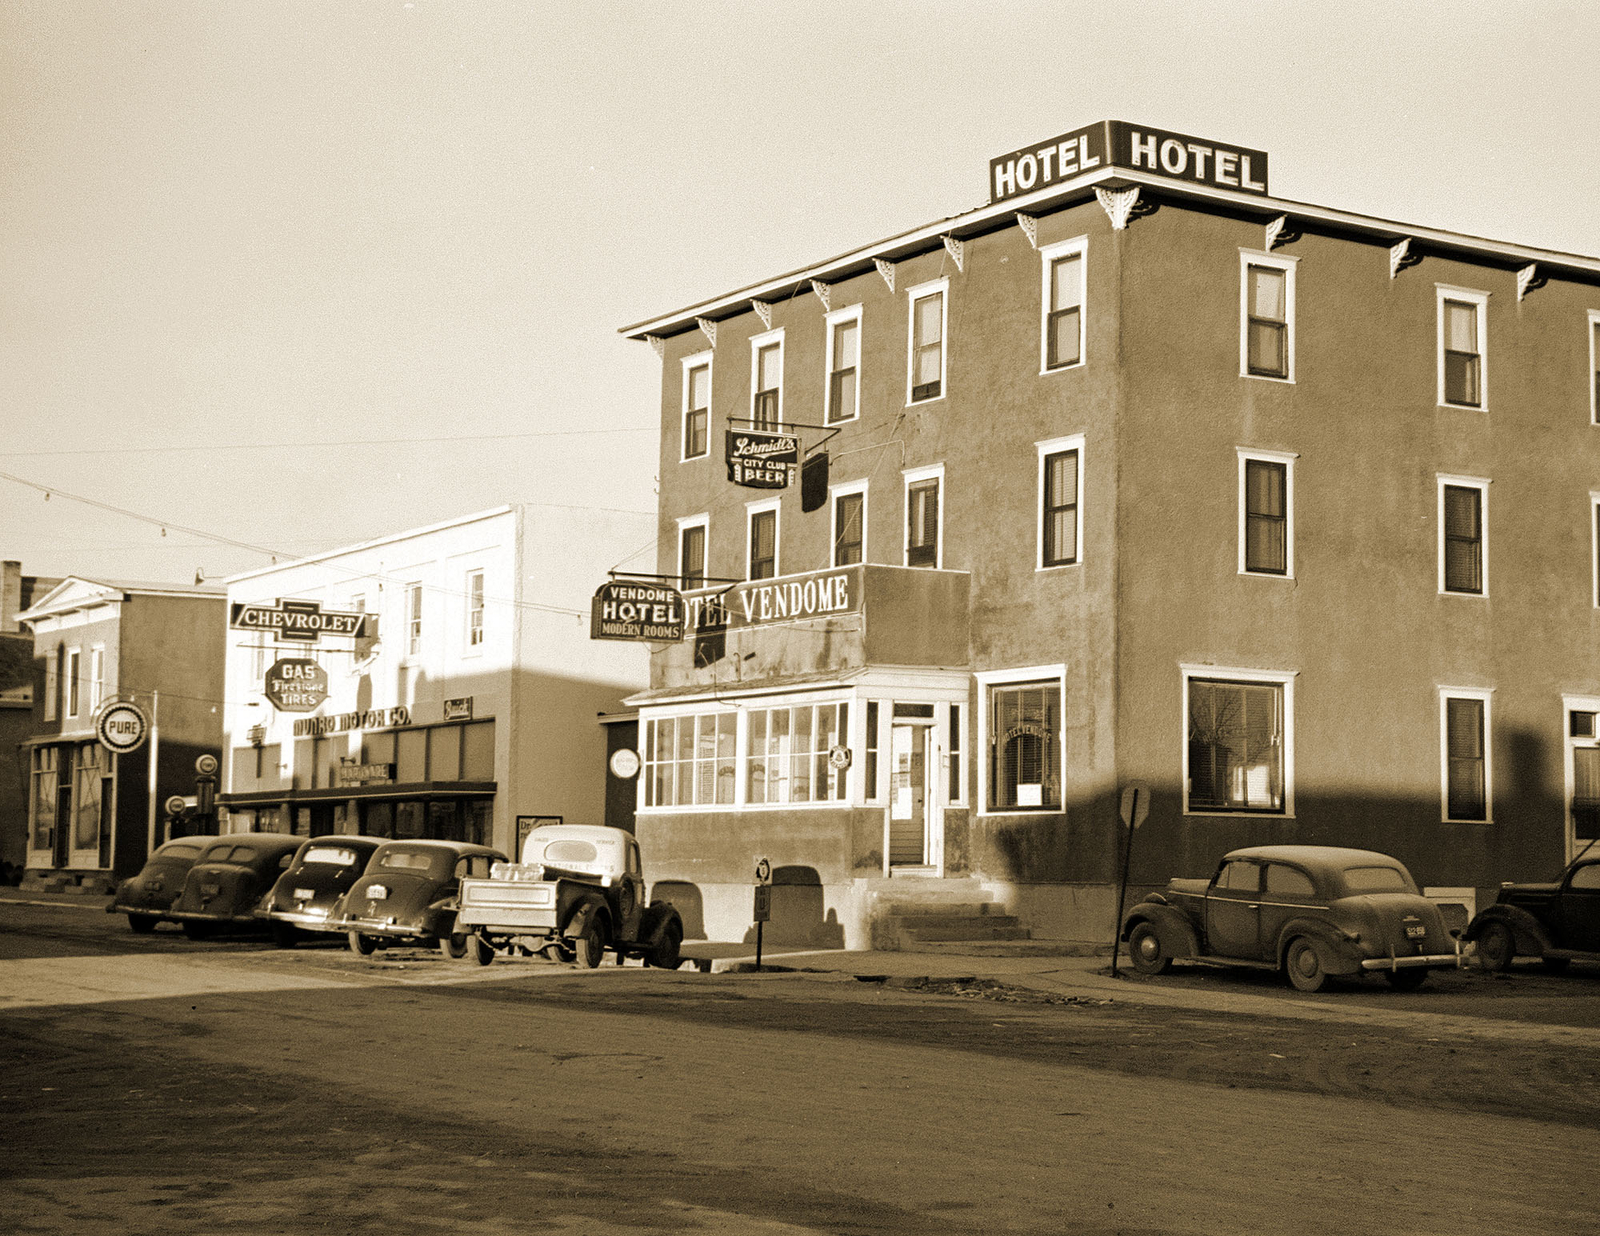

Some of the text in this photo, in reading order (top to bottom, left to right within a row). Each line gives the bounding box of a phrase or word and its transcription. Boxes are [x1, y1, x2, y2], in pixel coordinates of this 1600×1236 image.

[995, 134, 1100, 198] HOTEL
[1131, 131, 1265, 191] HOTEL
[733, 437, 796, 458] Schmidt's
[743, 458, 786, 470] CITY CLUB
[745, 468, 785, 483] BEER
[610, 586, 675, 602] VENDOME
[681, 574, 848, 630] TEL VENDOME
[602, 600, 681, 623] HOTEL
[244, 609, 356, 632] CHEVROLET
[602, 622, 680, 638] MODERN ROOMS
[282, 664, 315, 679] GAS
[271, 679, 325, 693] Firestone
[280, 693, 317, 705] TIRES
[340, 710, 385, 732] MOTOR
[390, 705, 412, 725] CO.
[109, 721, 137, 735] PURE
